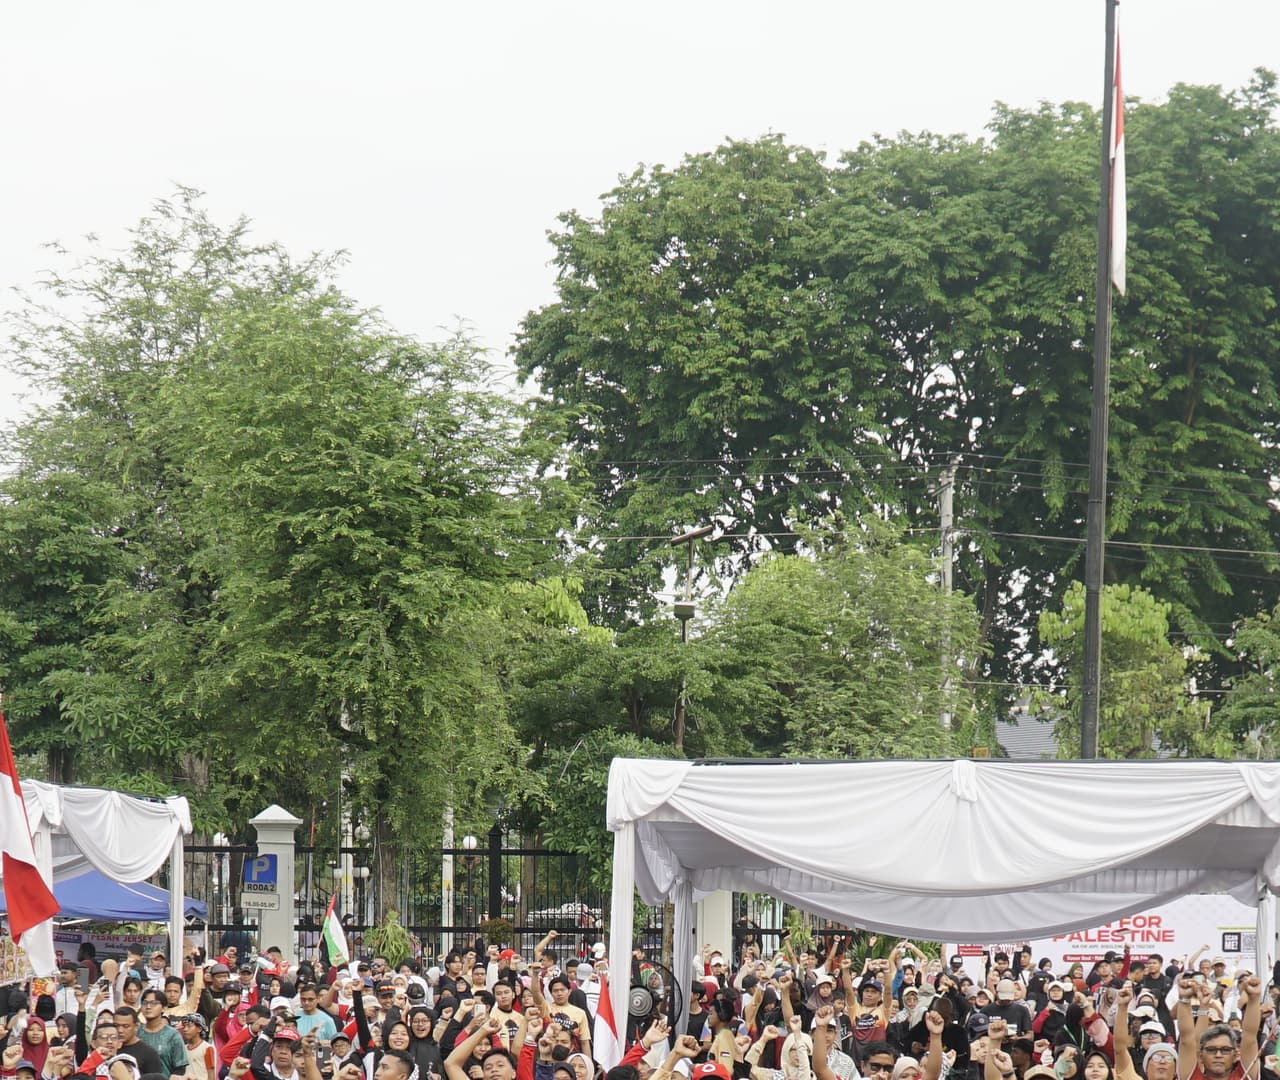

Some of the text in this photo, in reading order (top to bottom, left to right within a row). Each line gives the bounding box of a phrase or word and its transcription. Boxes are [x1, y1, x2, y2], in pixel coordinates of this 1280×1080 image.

[247, 883, 275, 892] RODA 2
[1119, 915, 1162, 928] FOR
